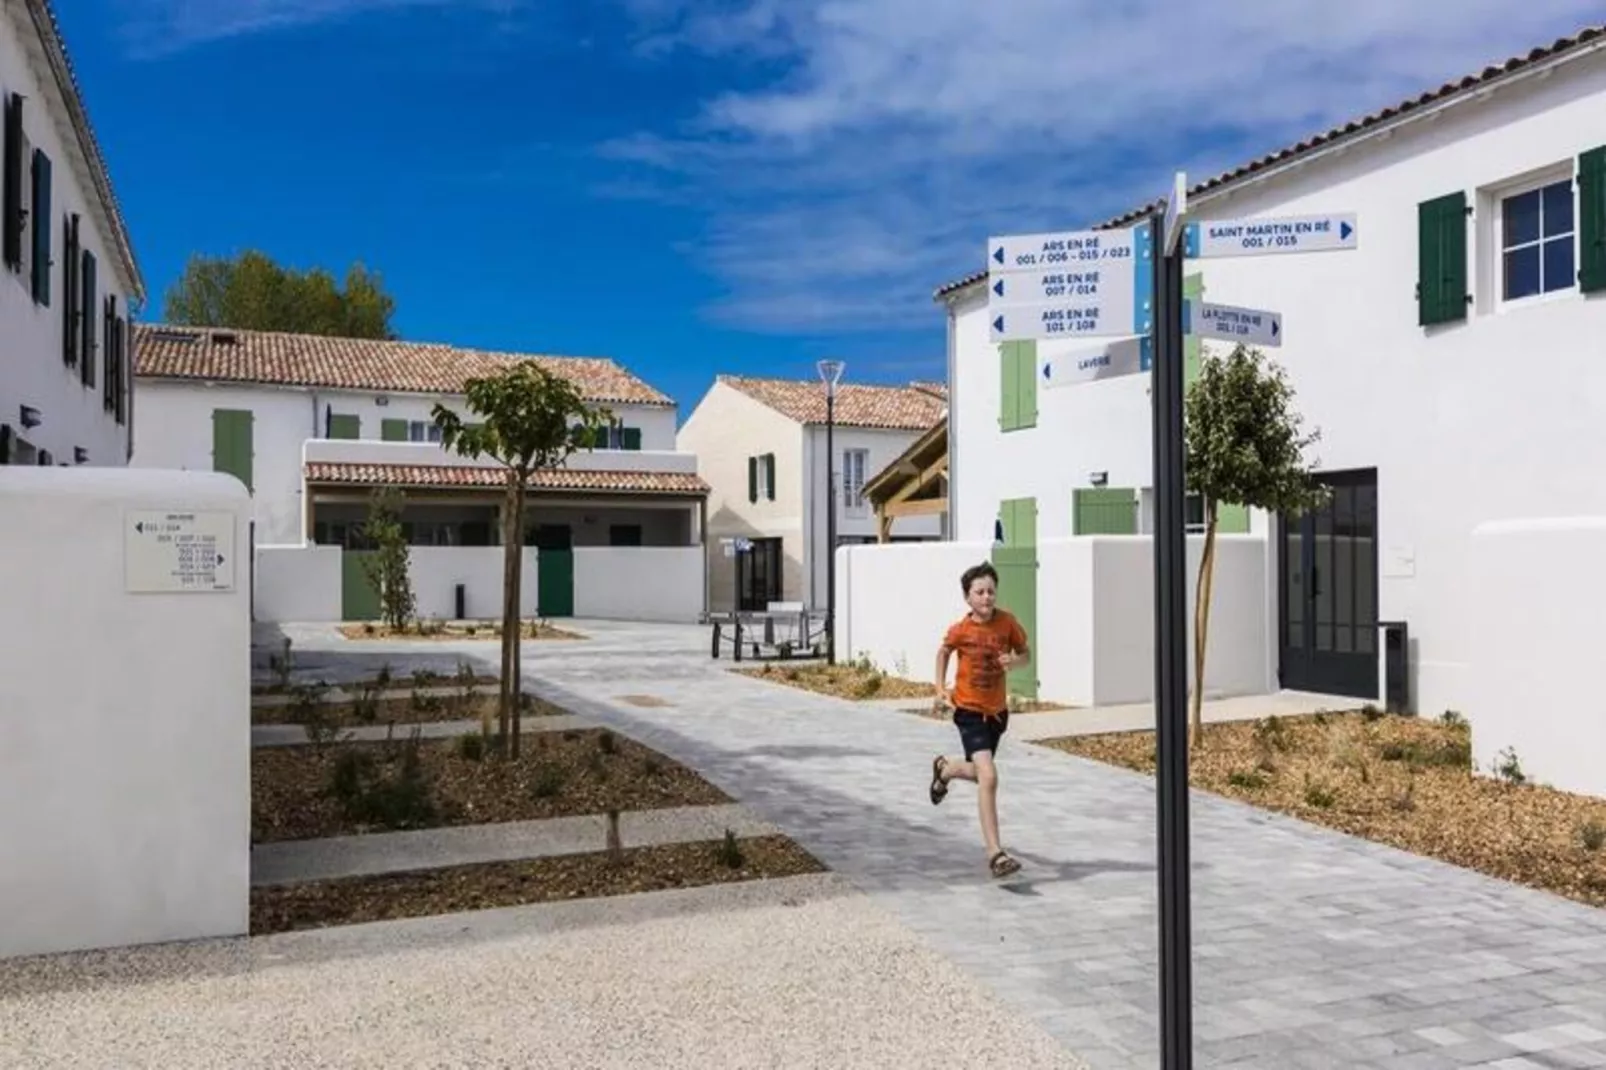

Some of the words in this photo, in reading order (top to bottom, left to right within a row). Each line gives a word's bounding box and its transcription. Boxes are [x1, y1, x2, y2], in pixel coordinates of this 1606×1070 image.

[1209, 227, 1243, 238] SAINT
[1246, 224, 1292, 235] MARTIN
[1295, 222, 1312, 233] EN
[1314, 219, 1330, 232] RÉ
[1043, 240, 1064, 251] ARS
[1067, 239, 1083, 250] EN
[1085, 236, 1099, 248] RÉ
[1242, 238, 1263, 248] 001
[1016, 254, 1036, 265] 001
[1047, 253, 1069, 263] 006
[1078, 249, 1099, 260] 015
[1109, 247, 1131, 258] 023
[1042, 274, 1064, 285] ARS
[1067, 273, 1083, 284] EN
[1045, 286, 1066, 297] 007
[1076, 285, 1097, 295] 014
[1042, 310, 1064, 321] ARS
[1067, 309, 1083, 319] EN
[1046, 322, 1065, 333] 101
[1077, 320, 1096, 331] 108
